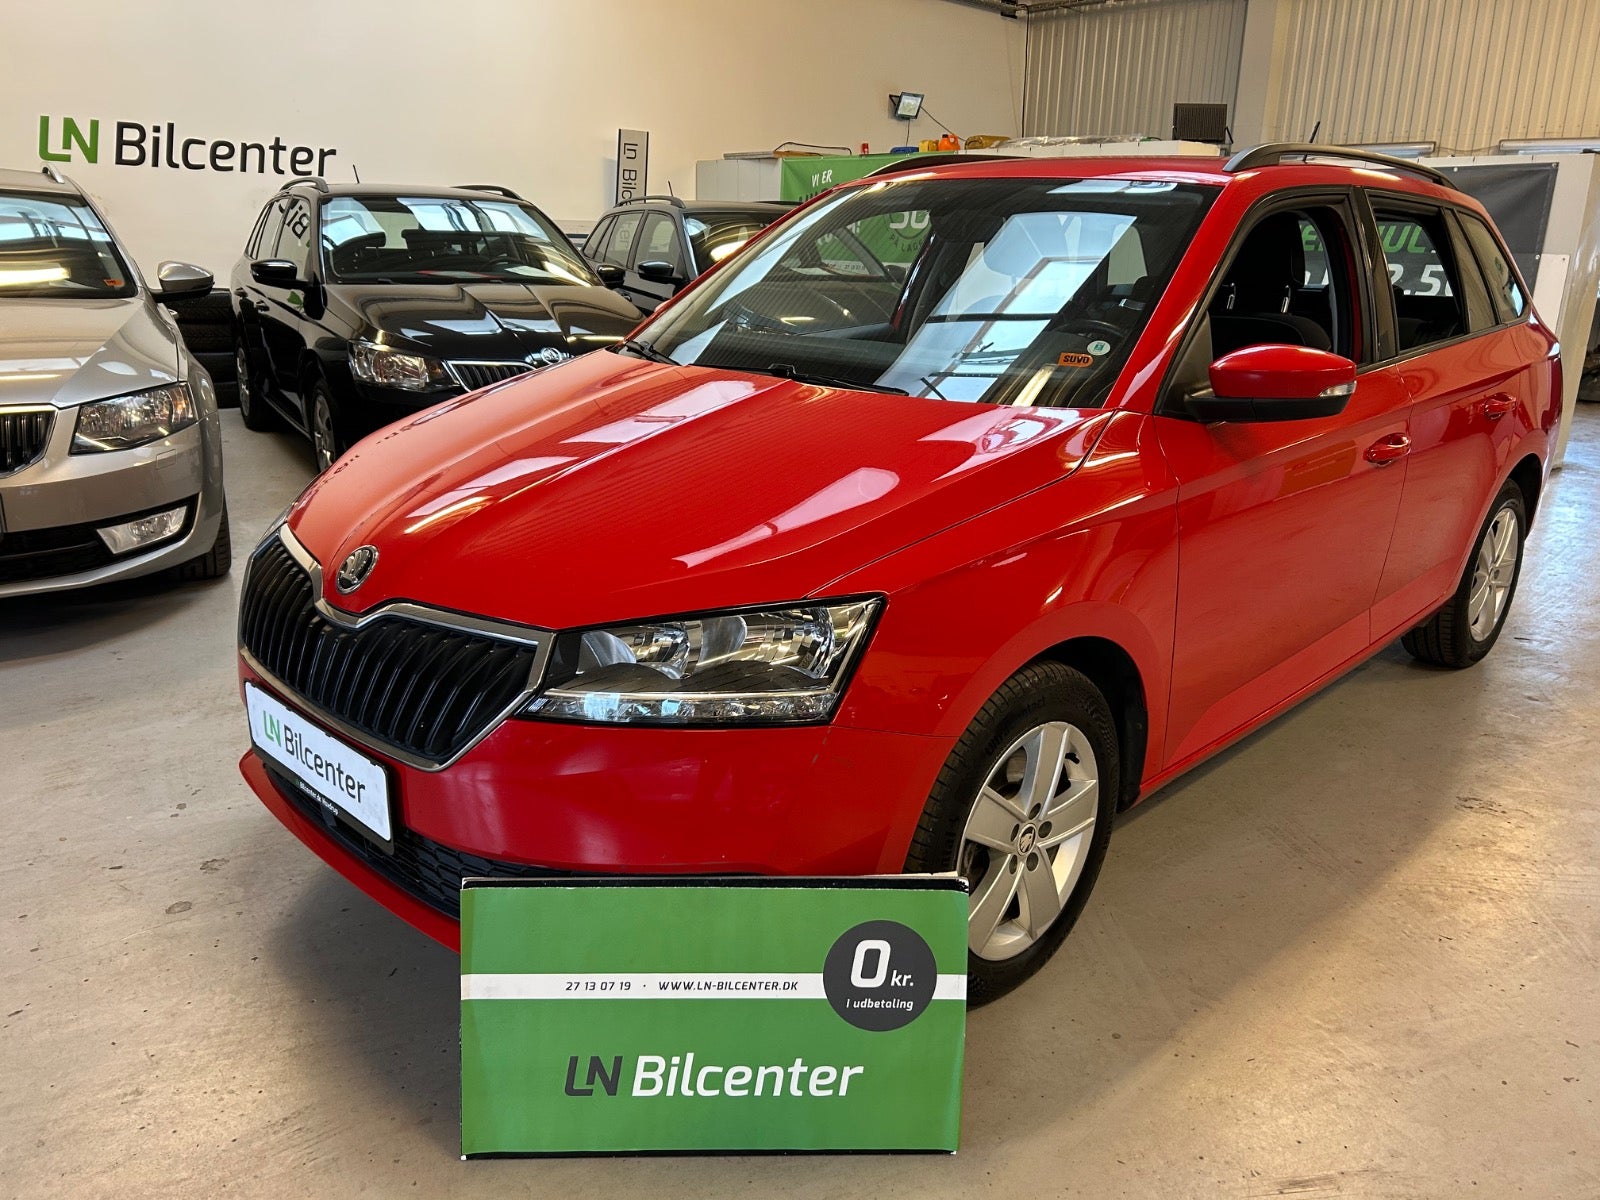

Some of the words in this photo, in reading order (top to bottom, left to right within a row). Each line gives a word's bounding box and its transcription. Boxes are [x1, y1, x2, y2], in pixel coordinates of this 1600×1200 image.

[39, 116, 99, 163] LN
[114, 121, 337, 178] Bilcenter
[811, 173, 820, 188] VI
[821, 168, 833, 184] ER
[263, 709, 282, 748] LN
[283, 724, 367, 803] Bilcenter
[565, 980, 581, 992] 27
[584, 980, 596, 992] 13
[600, 980, 616, 992] 07
[619, 980, 631, 992] 19
[658, 980, 799, 992] WWW.LN-BILCENTER.DK
[891, 969, 914, 987] kr.
[853, 997, 914, 1012] udbetaling
[564, 1055, 623, 1097] LN
[631, 1052, 865, 1097] Bilcenter
